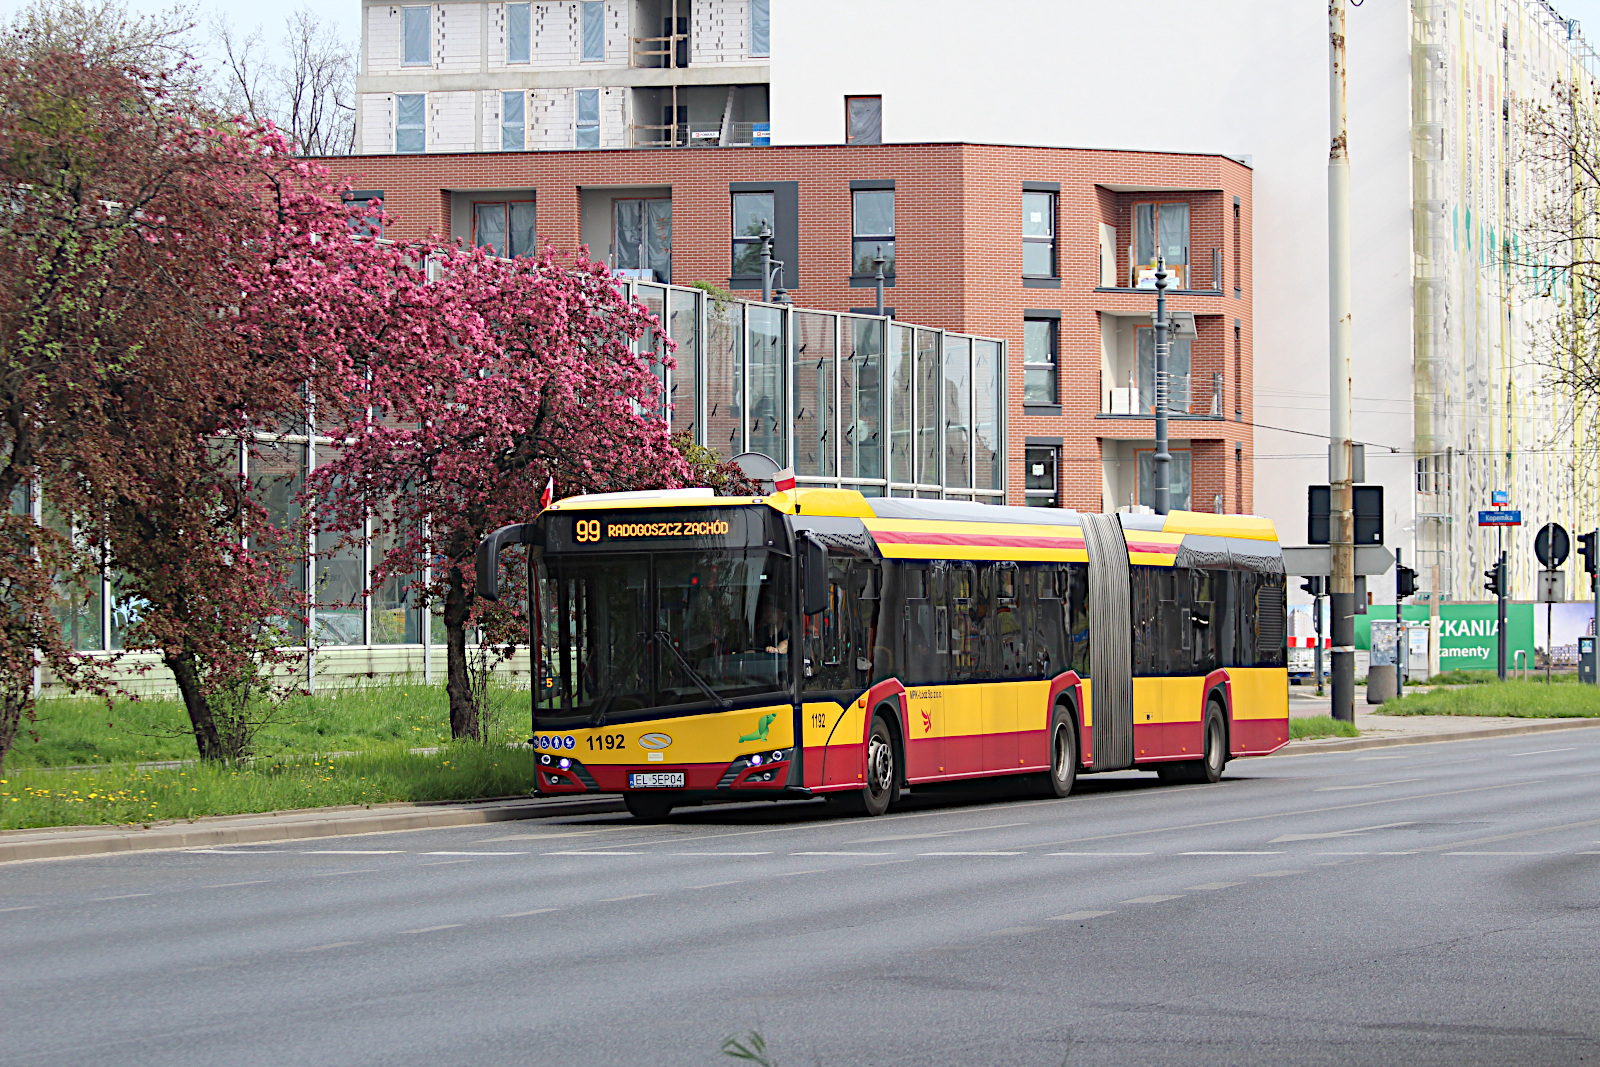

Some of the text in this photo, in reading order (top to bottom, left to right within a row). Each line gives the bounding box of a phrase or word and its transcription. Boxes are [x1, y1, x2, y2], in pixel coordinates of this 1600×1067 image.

[1485, 514, 1514, 522] Kopernika
[576, 519, 729, 542] 99 RADOGOSZCZ ZACHÓD
[545, 677, 553, 688] 5
[811, 713, 826, 728] 1192
[586, 734, 626, 751] 1192
[635, 774, 682, 785] EL 5EP04
